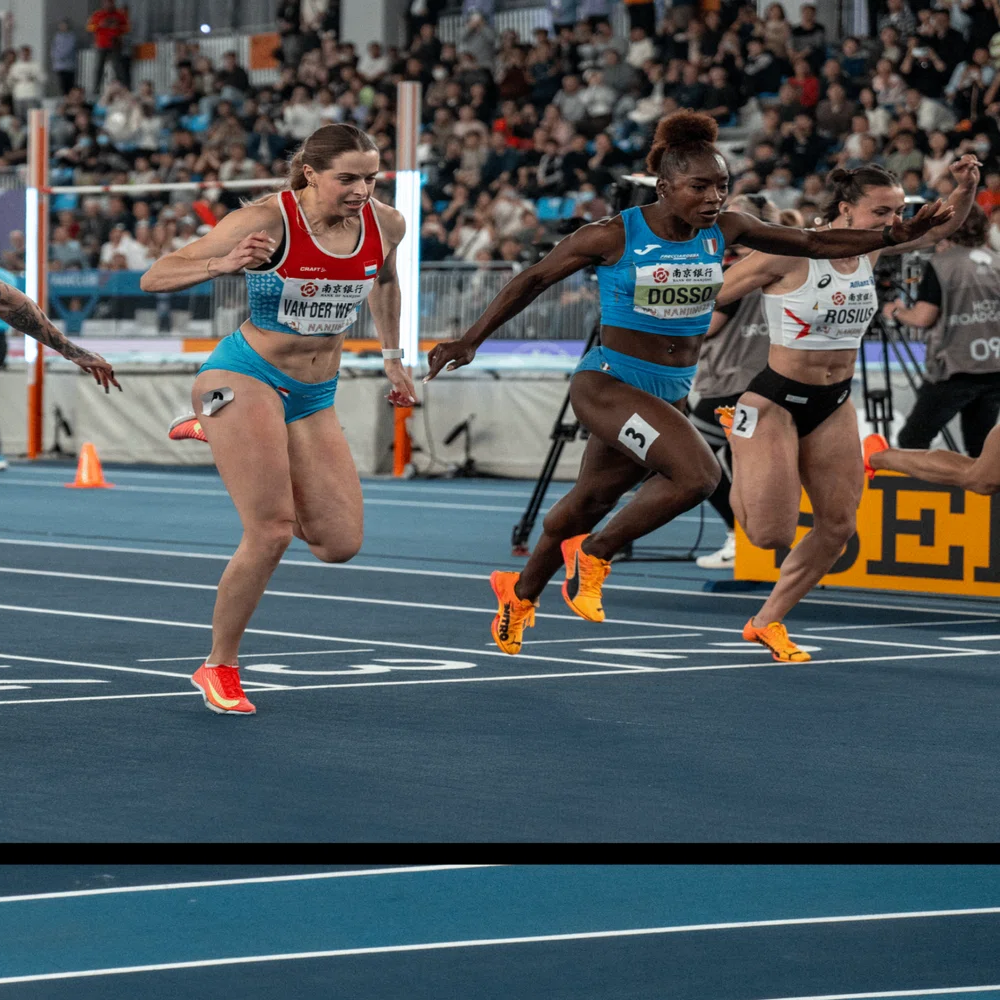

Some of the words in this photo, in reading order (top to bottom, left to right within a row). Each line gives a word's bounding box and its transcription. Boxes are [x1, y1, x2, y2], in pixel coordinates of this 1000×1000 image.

[672, 267, 713, 278] 南京银行
[322, 284, 364, 294] 南京银行
[647, 286, 713, 305] DOSSO
[284, 299, 308, 317] VAN
[310, 301, 333, 318] DER
[824, 307, 874, 324] ROSIUS
[736, 409, 748, 432] 2
[625, 427, 646, 449] 3
